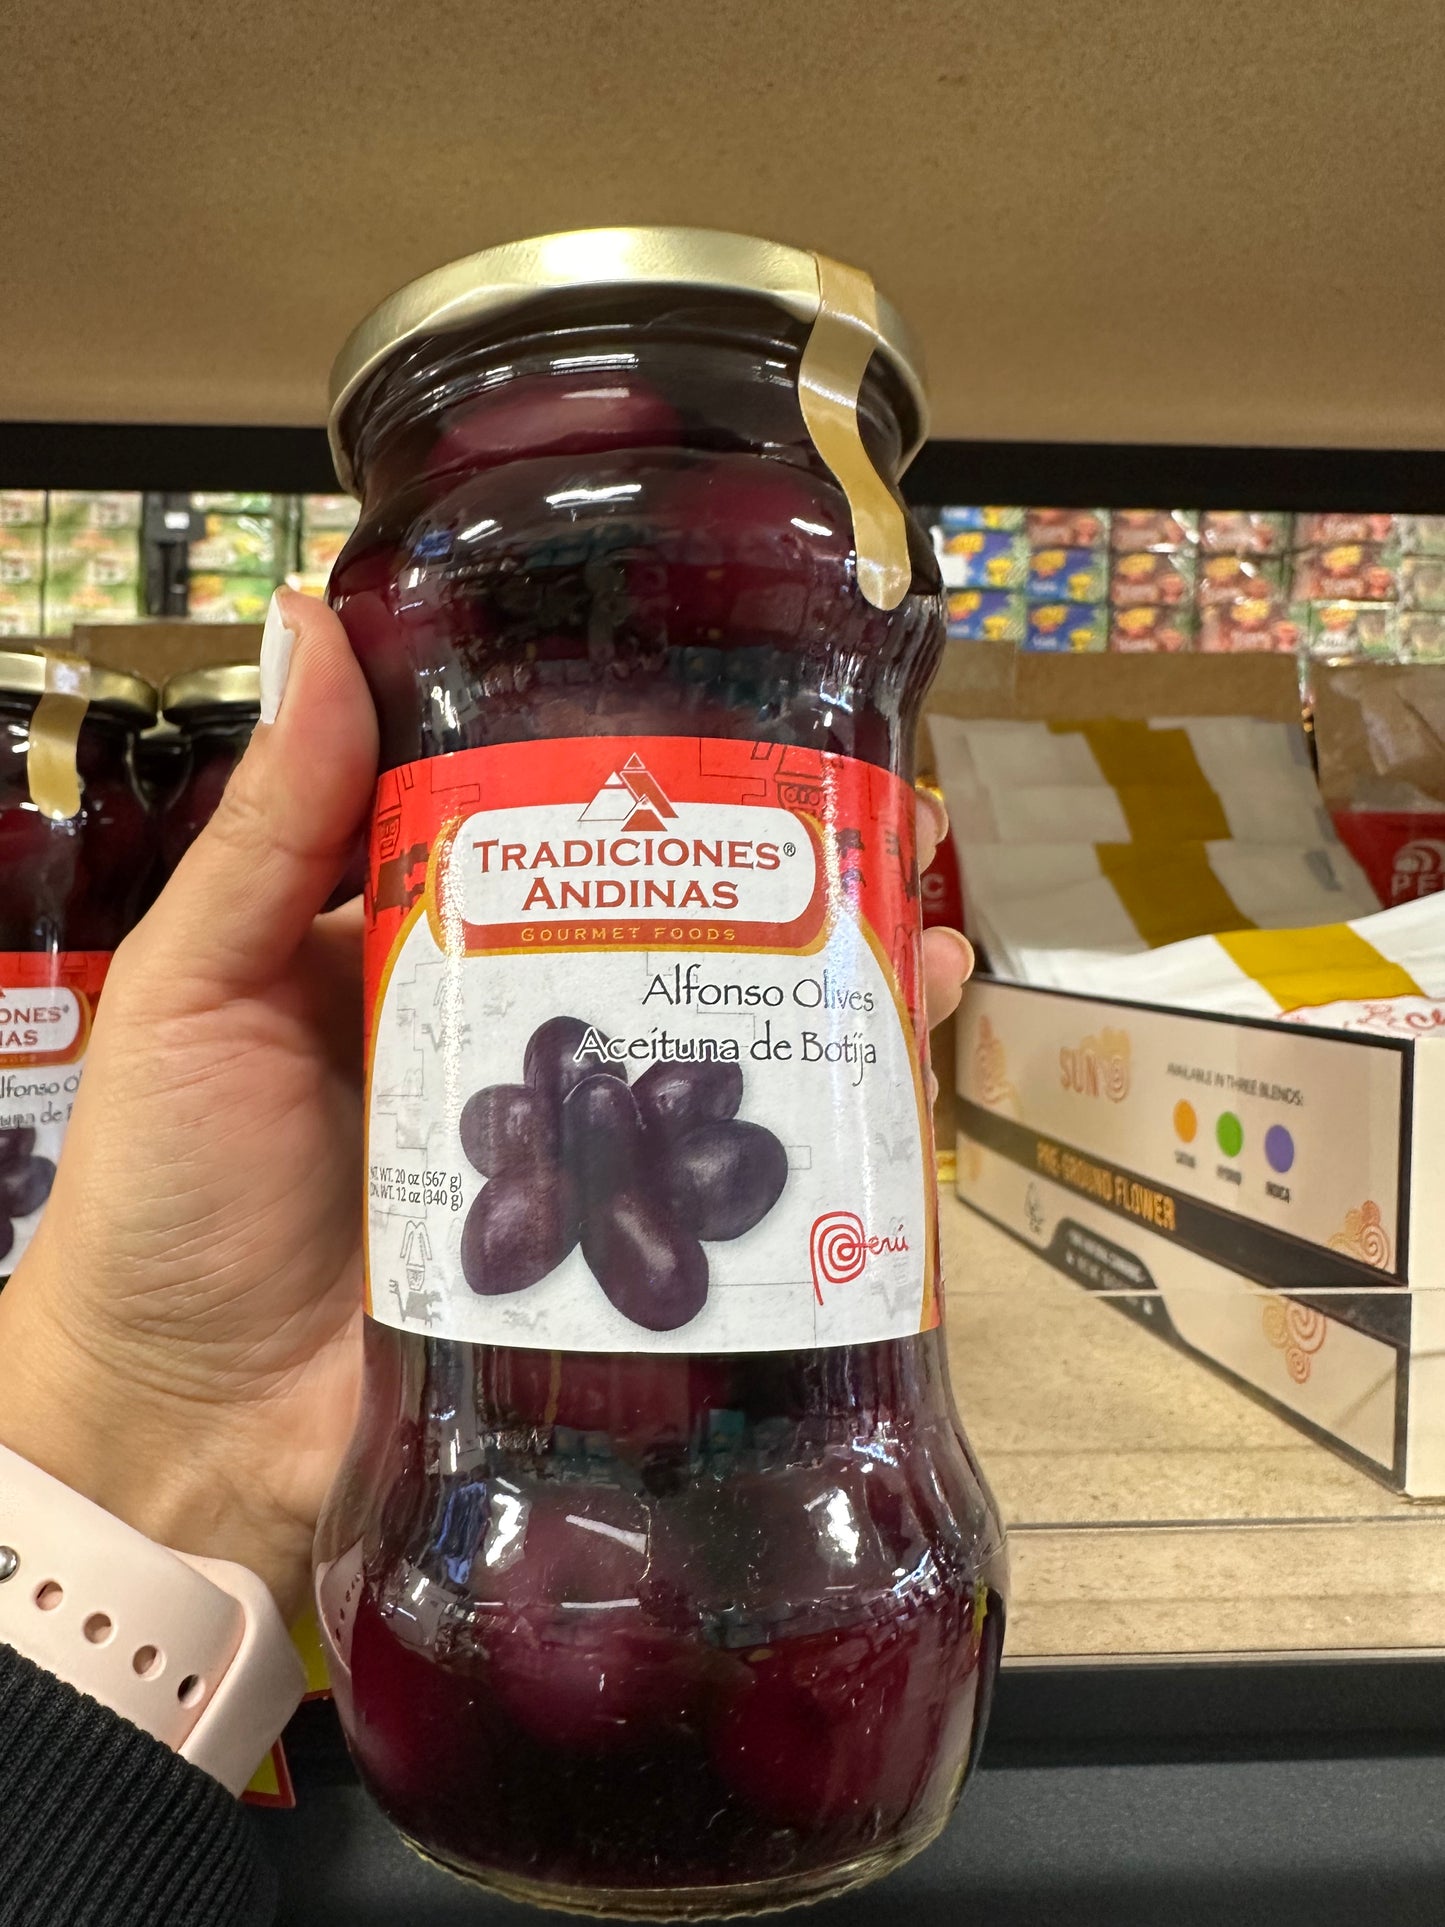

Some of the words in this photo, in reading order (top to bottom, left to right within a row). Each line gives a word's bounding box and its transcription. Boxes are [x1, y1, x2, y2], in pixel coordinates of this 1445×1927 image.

[521, 876, 738, 911] ANDINAS
[521, 925, 642, 943] GOURMET
[654, 926, 737, 942] FOODS
[641, 962, 784, 1007] Alfonso
[792, 968, 875, 1013] Olives
[573, 1026, 740, 1062] Aceituna
[749, 1020, 793, 1061] de
[800, 1031, 877, 1087] Botija
[395, 1168, 406, 1185] 20
[408, 1173, 420, 1186] oz
[421, 1170, 447, 1188] (567
[449, 1172, 462, 1193] g)
[396, 1186, 407, 1202] 12
[408, 1191, 421, 1204] oz
[422, 1188, 448, 1206] (340
[450, 1190, 464, 1212] g)
[1114, 1175, 1176, 1232] FLOWER
[809, 1210, 909, 1306] Perú
